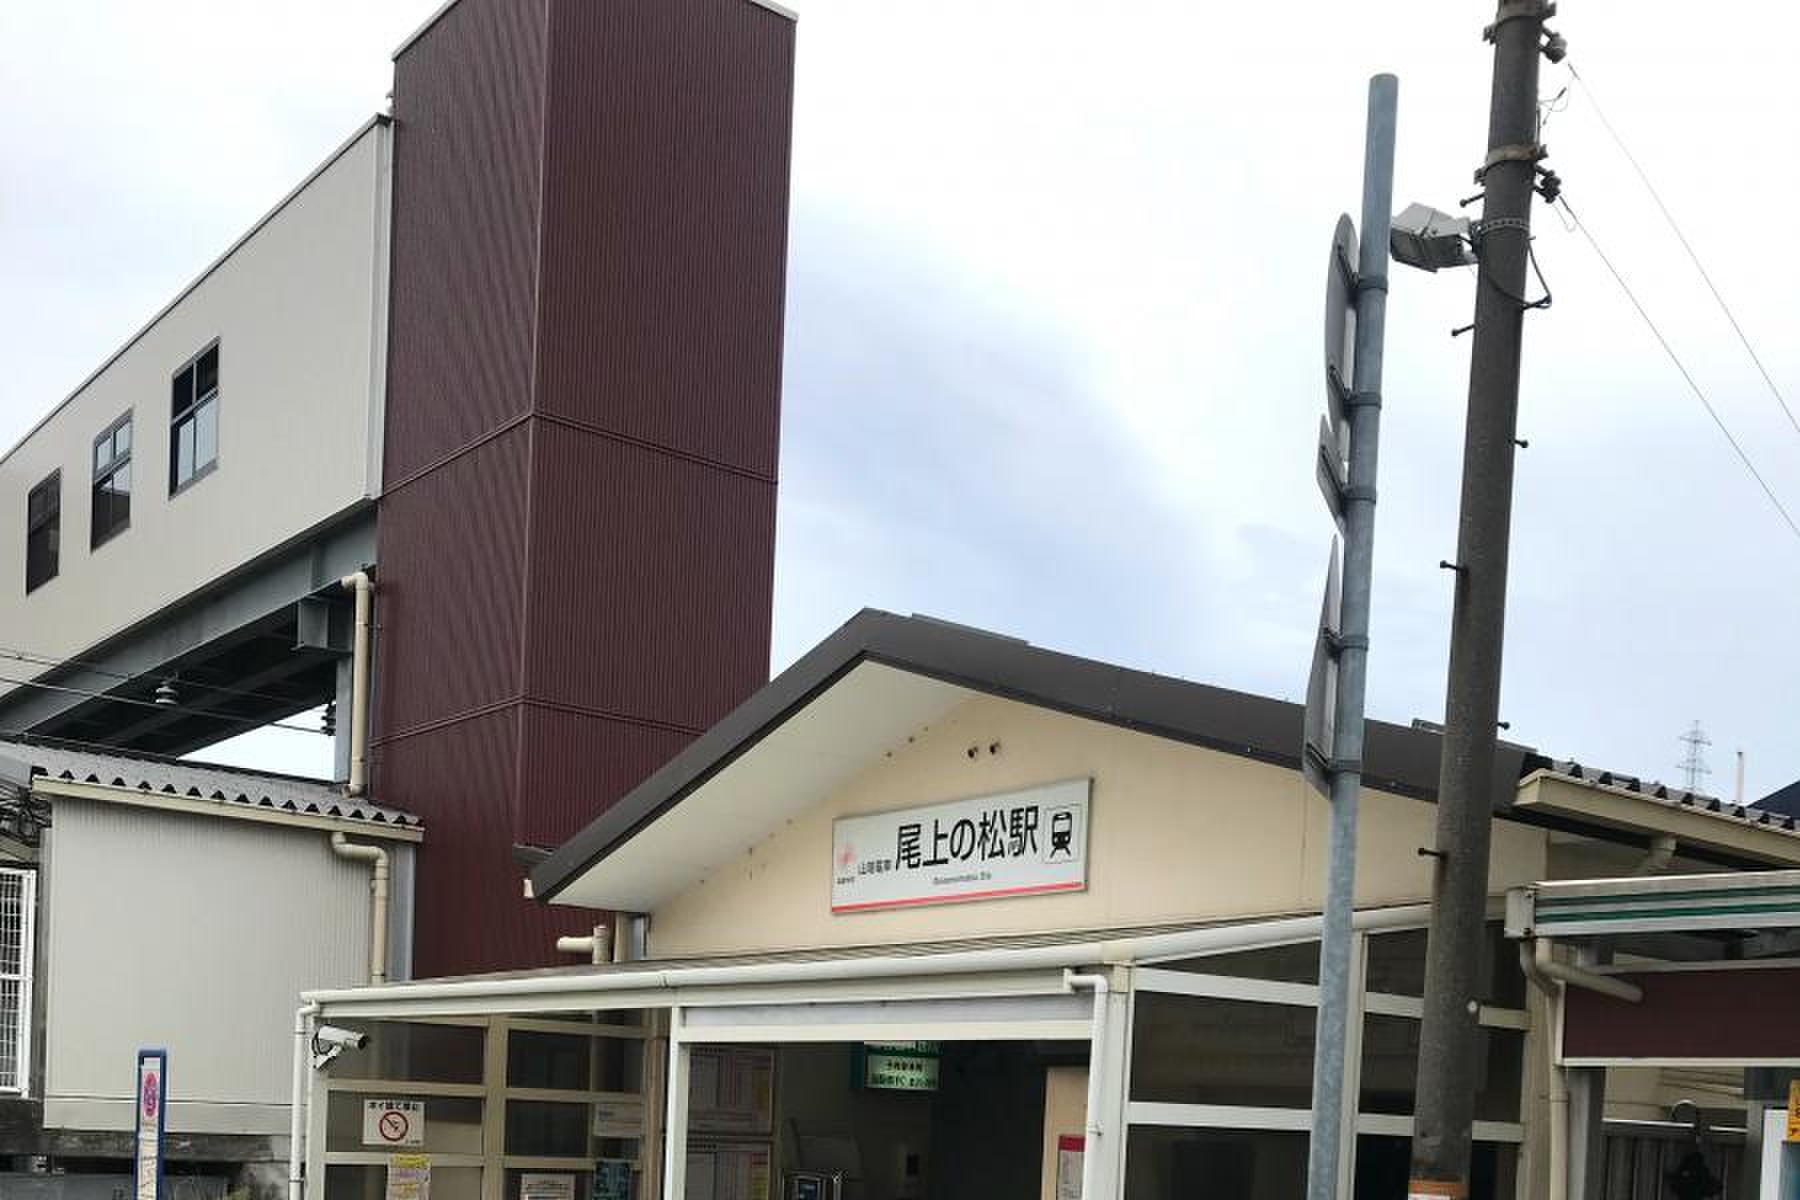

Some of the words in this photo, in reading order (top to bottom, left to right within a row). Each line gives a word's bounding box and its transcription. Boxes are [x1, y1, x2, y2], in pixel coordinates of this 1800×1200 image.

[896, 805, 1039, 870] 尾上の松駅
